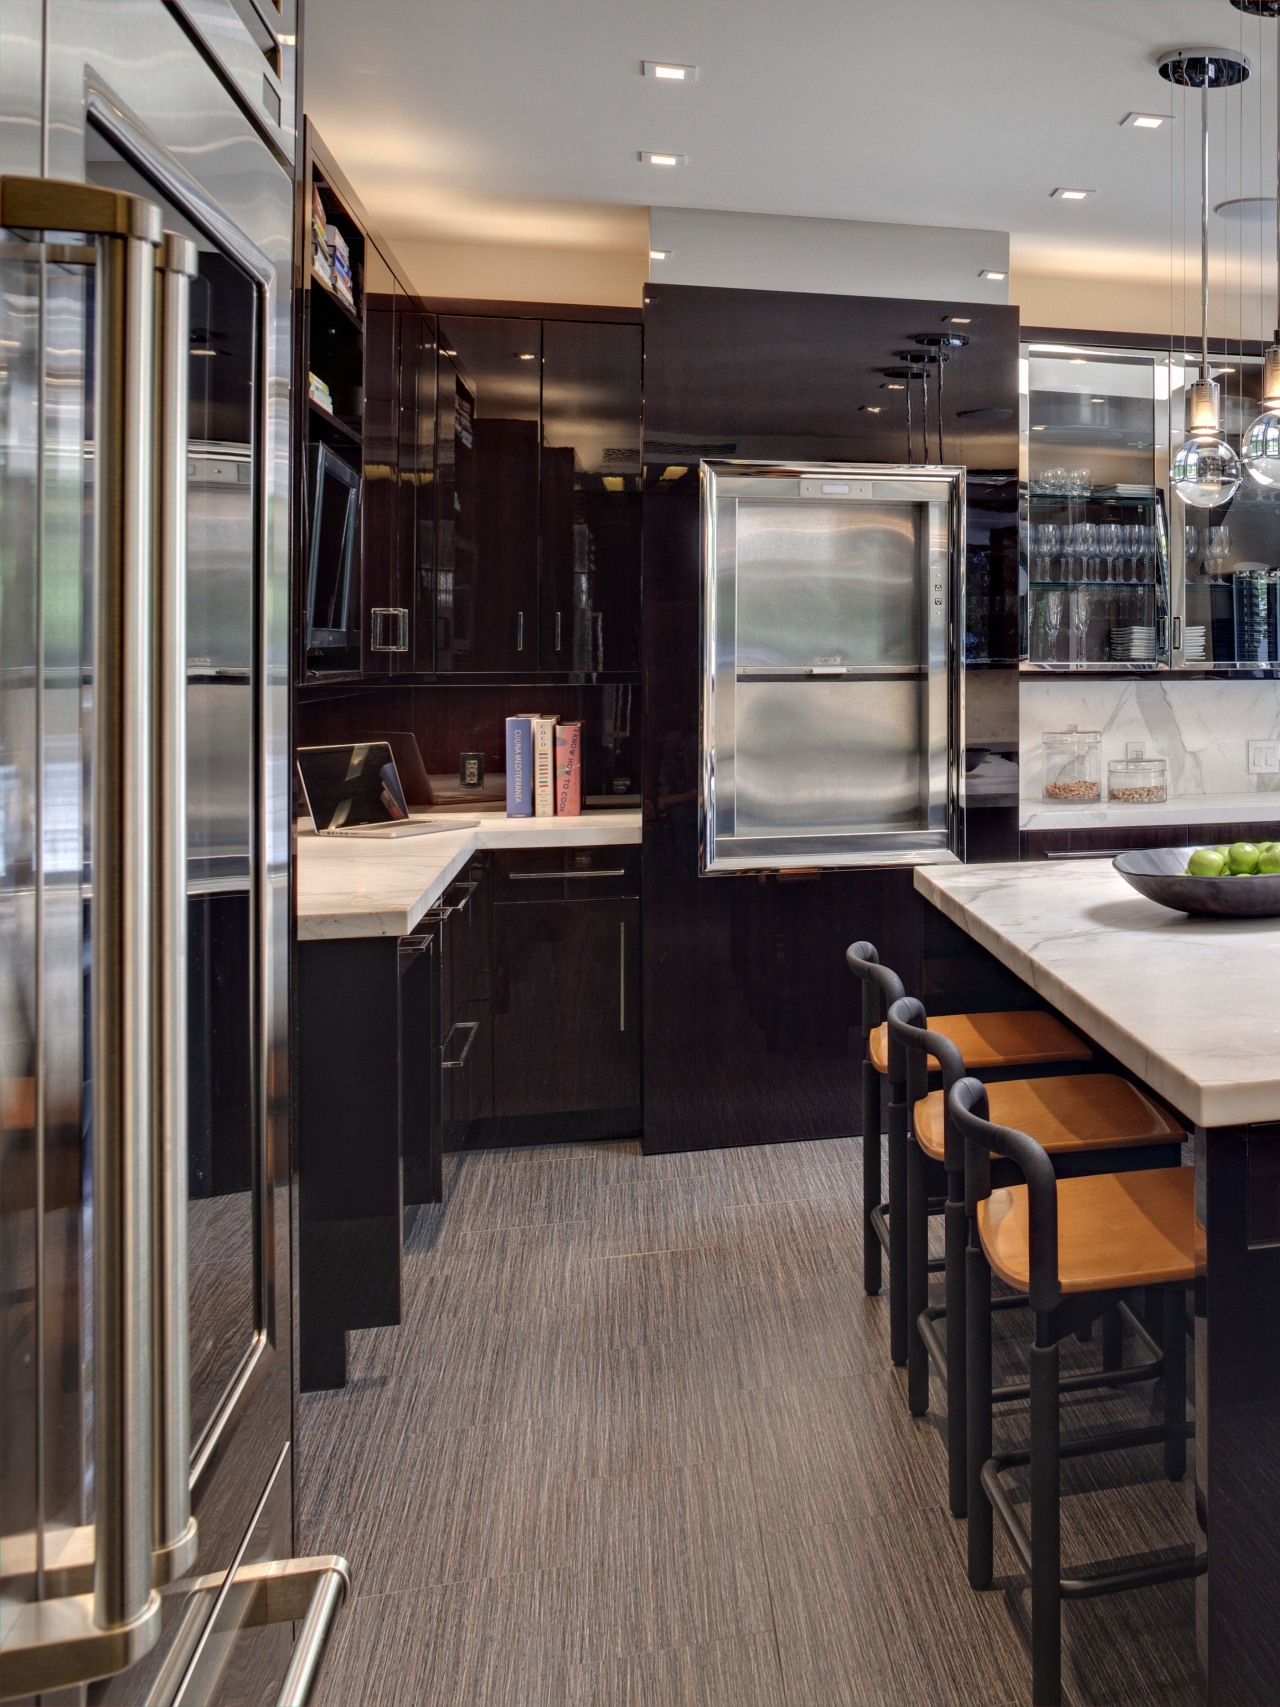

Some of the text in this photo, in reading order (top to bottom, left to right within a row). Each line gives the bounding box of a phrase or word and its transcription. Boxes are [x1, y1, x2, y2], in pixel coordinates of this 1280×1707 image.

[569, 734, 578, 756] KNOW
[565, 758, 574, 776] HOW
[562, 779, 570, 789] TO
